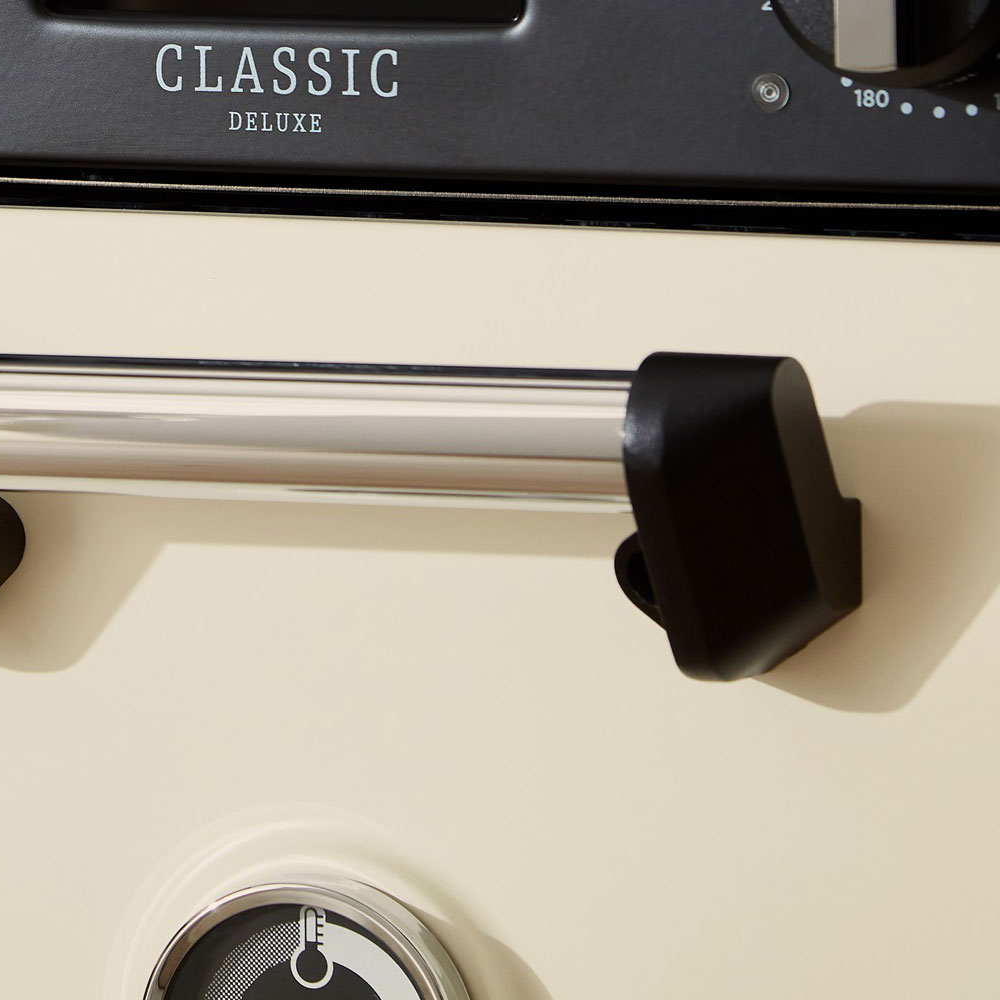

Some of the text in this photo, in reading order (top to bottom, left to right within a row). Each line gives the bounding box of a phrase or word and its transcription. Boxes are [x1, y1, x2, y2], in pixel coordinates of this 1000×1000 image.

[155, 43, 399, 98] CLASSIC
[853, 88, 890, 108] 180
[228, 111, 323, 133] DELUXE
